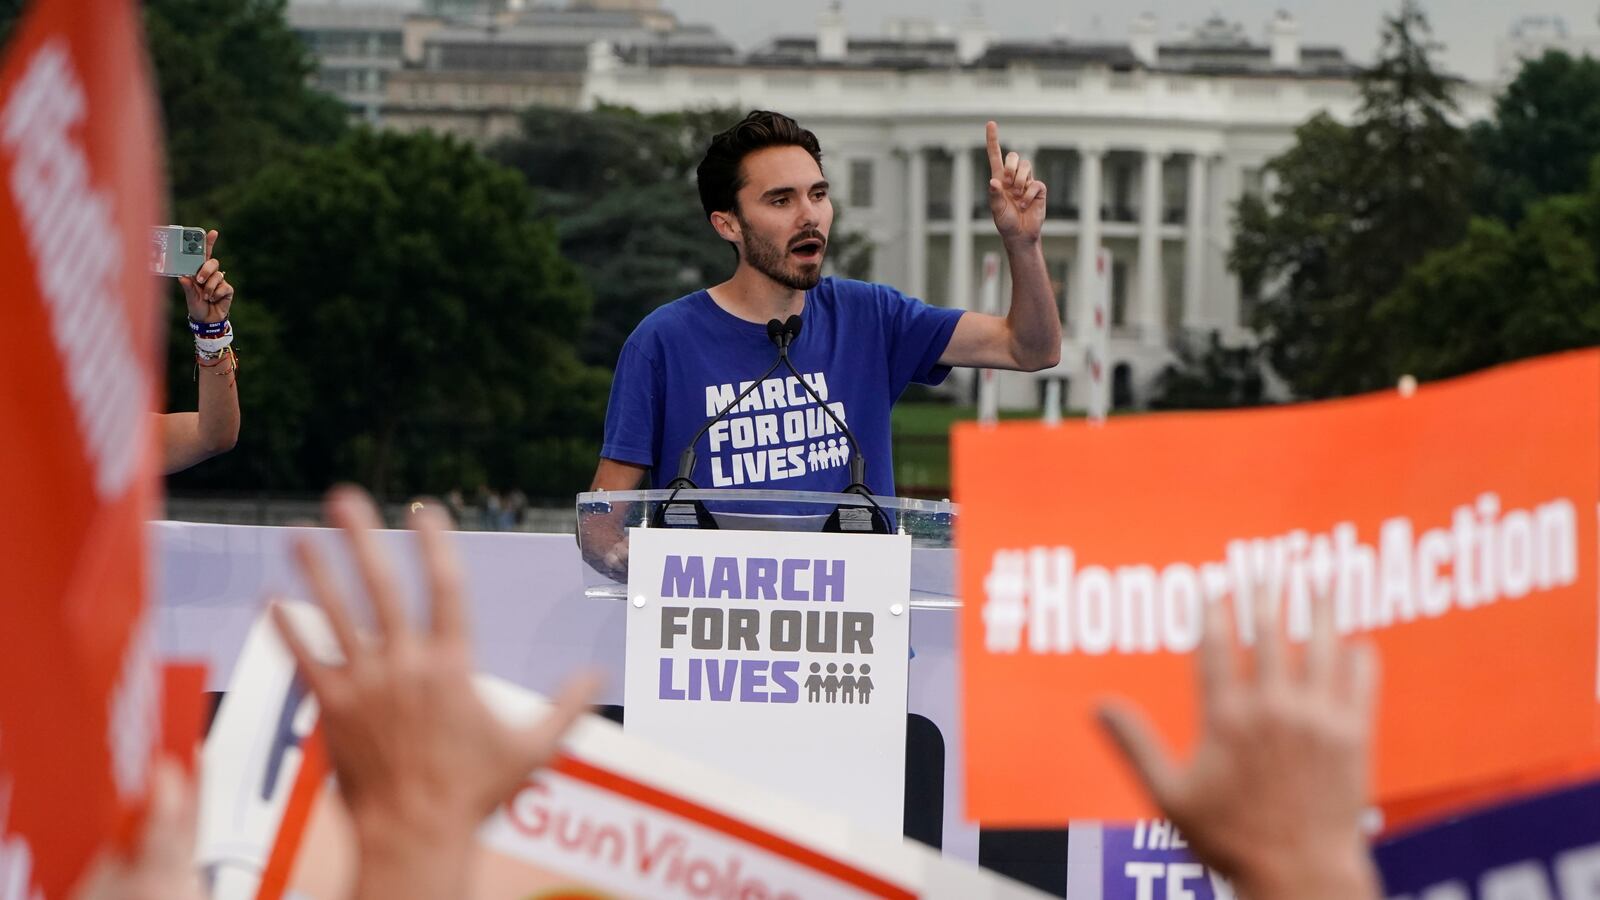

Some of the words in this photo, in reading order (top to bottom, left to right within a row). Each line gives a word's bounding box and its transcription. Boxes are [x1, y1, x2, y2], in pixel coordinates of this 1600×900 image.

[705, 372, 829, 418] MARCH
[708, 413, 780, 453] FOR
[783, 401, 849, 443] OUR
[710, 445, 807, 488] LIVES
[660, 554, 846, 603] MARCH
[981, 492, 1578, 655] #HonorWithAction
[660, 606, 761, 652] FOR
[769, 609, 875, 655] OUR
[658, 657, 801, 704] LIVES
